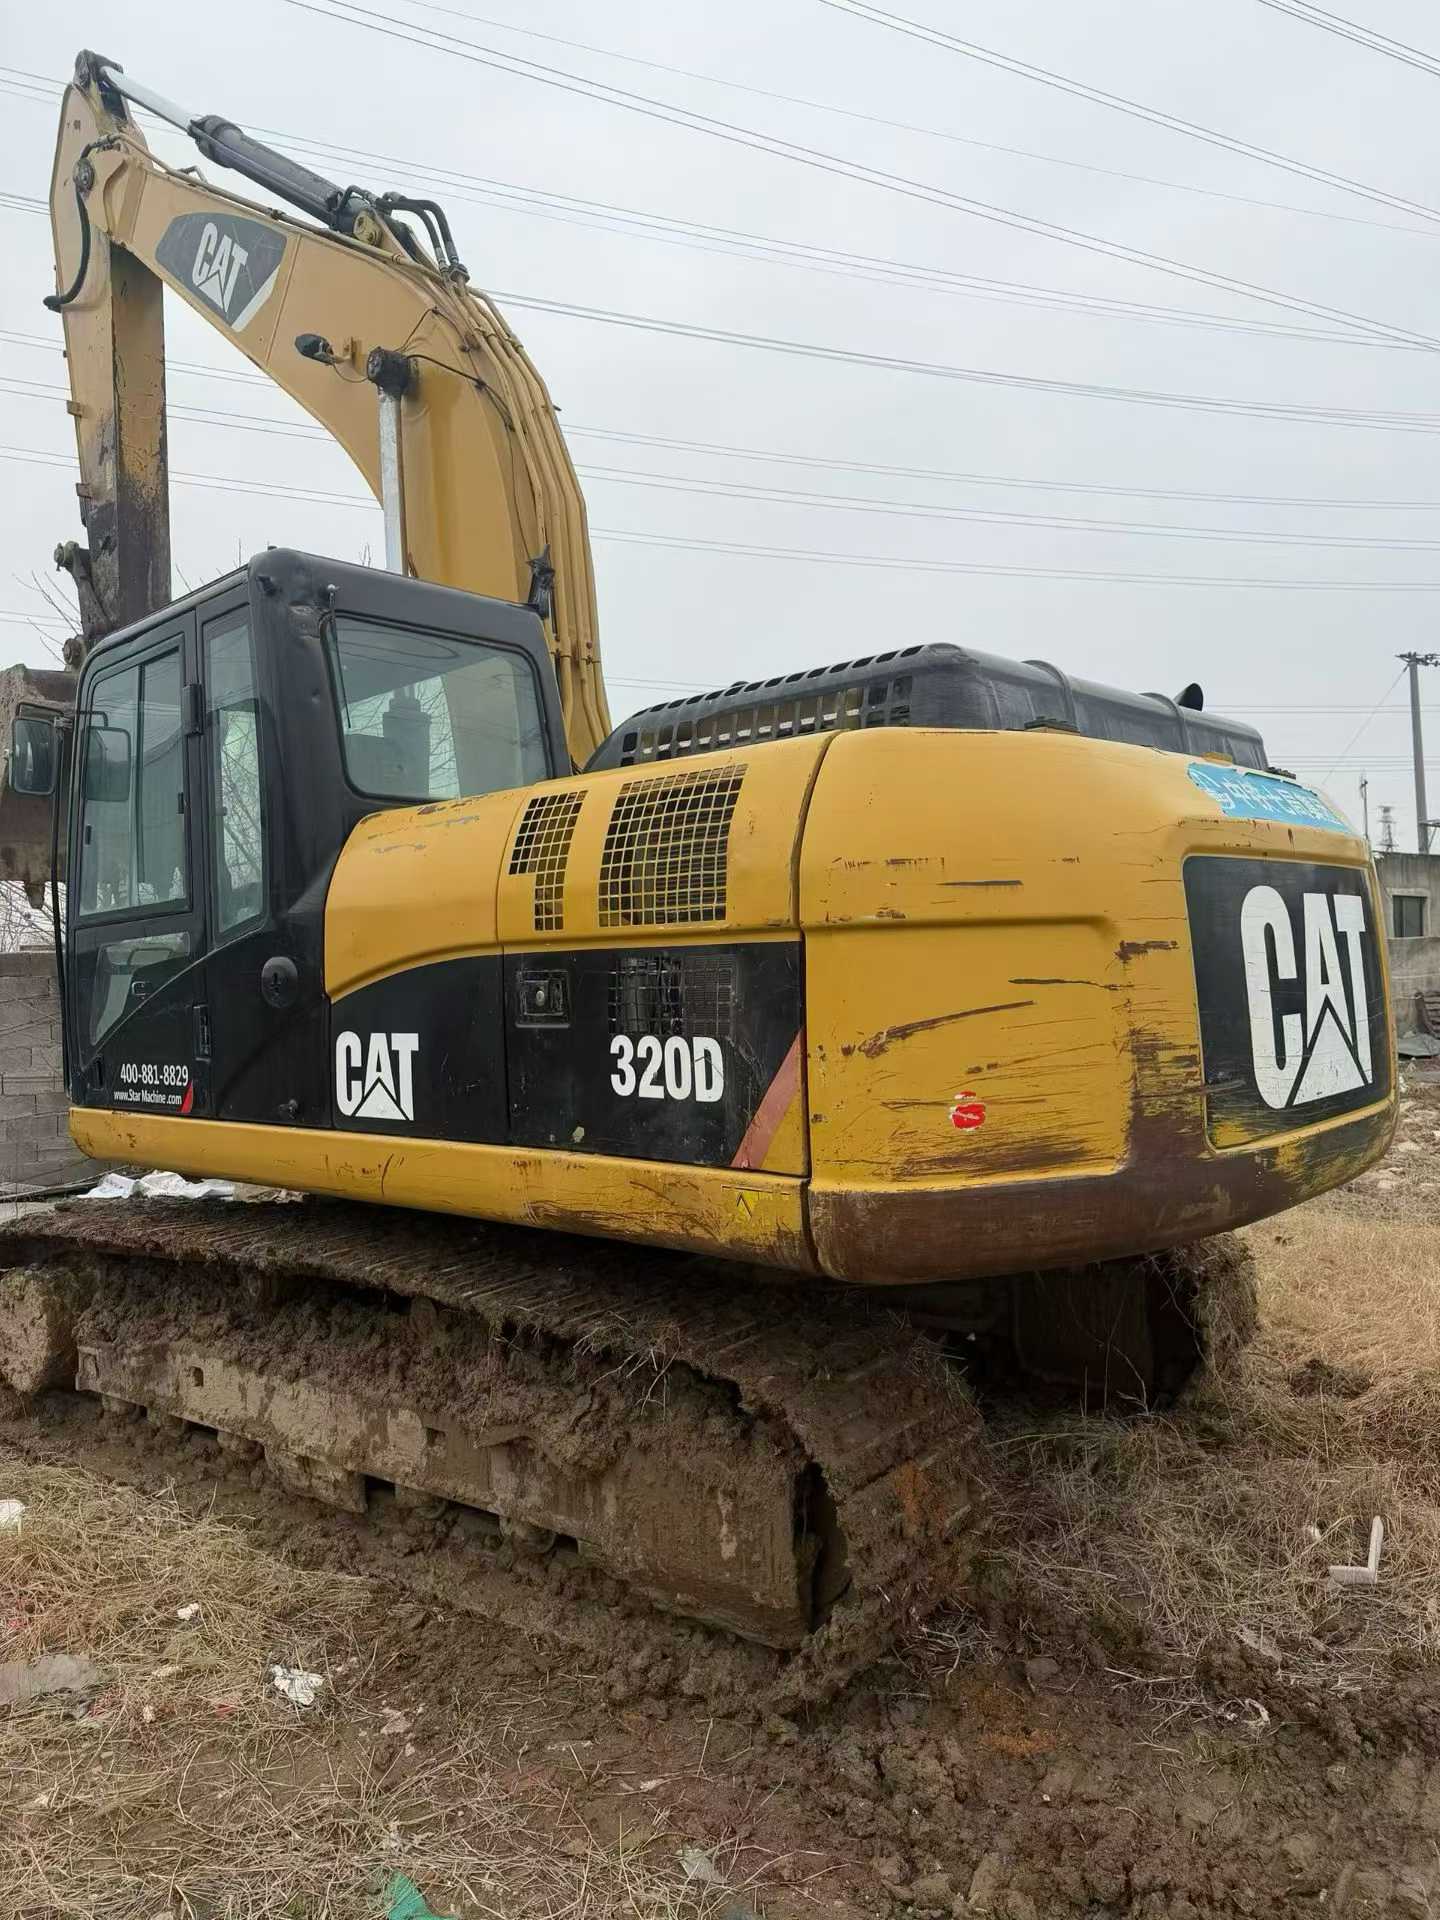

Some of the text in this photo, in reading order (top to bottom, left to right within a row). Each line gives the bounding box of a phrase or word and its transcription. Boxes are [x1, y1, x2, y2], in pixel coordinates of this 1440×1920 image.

[192, 222, 249, 313] CAT
[1240, 885, 1374, 1110] CAT
[120, 1063, 189, 1087] 400-881-8829
[335, 1030, 419, 1121] CAT
[610, 1034, 725, 1103] 320D
